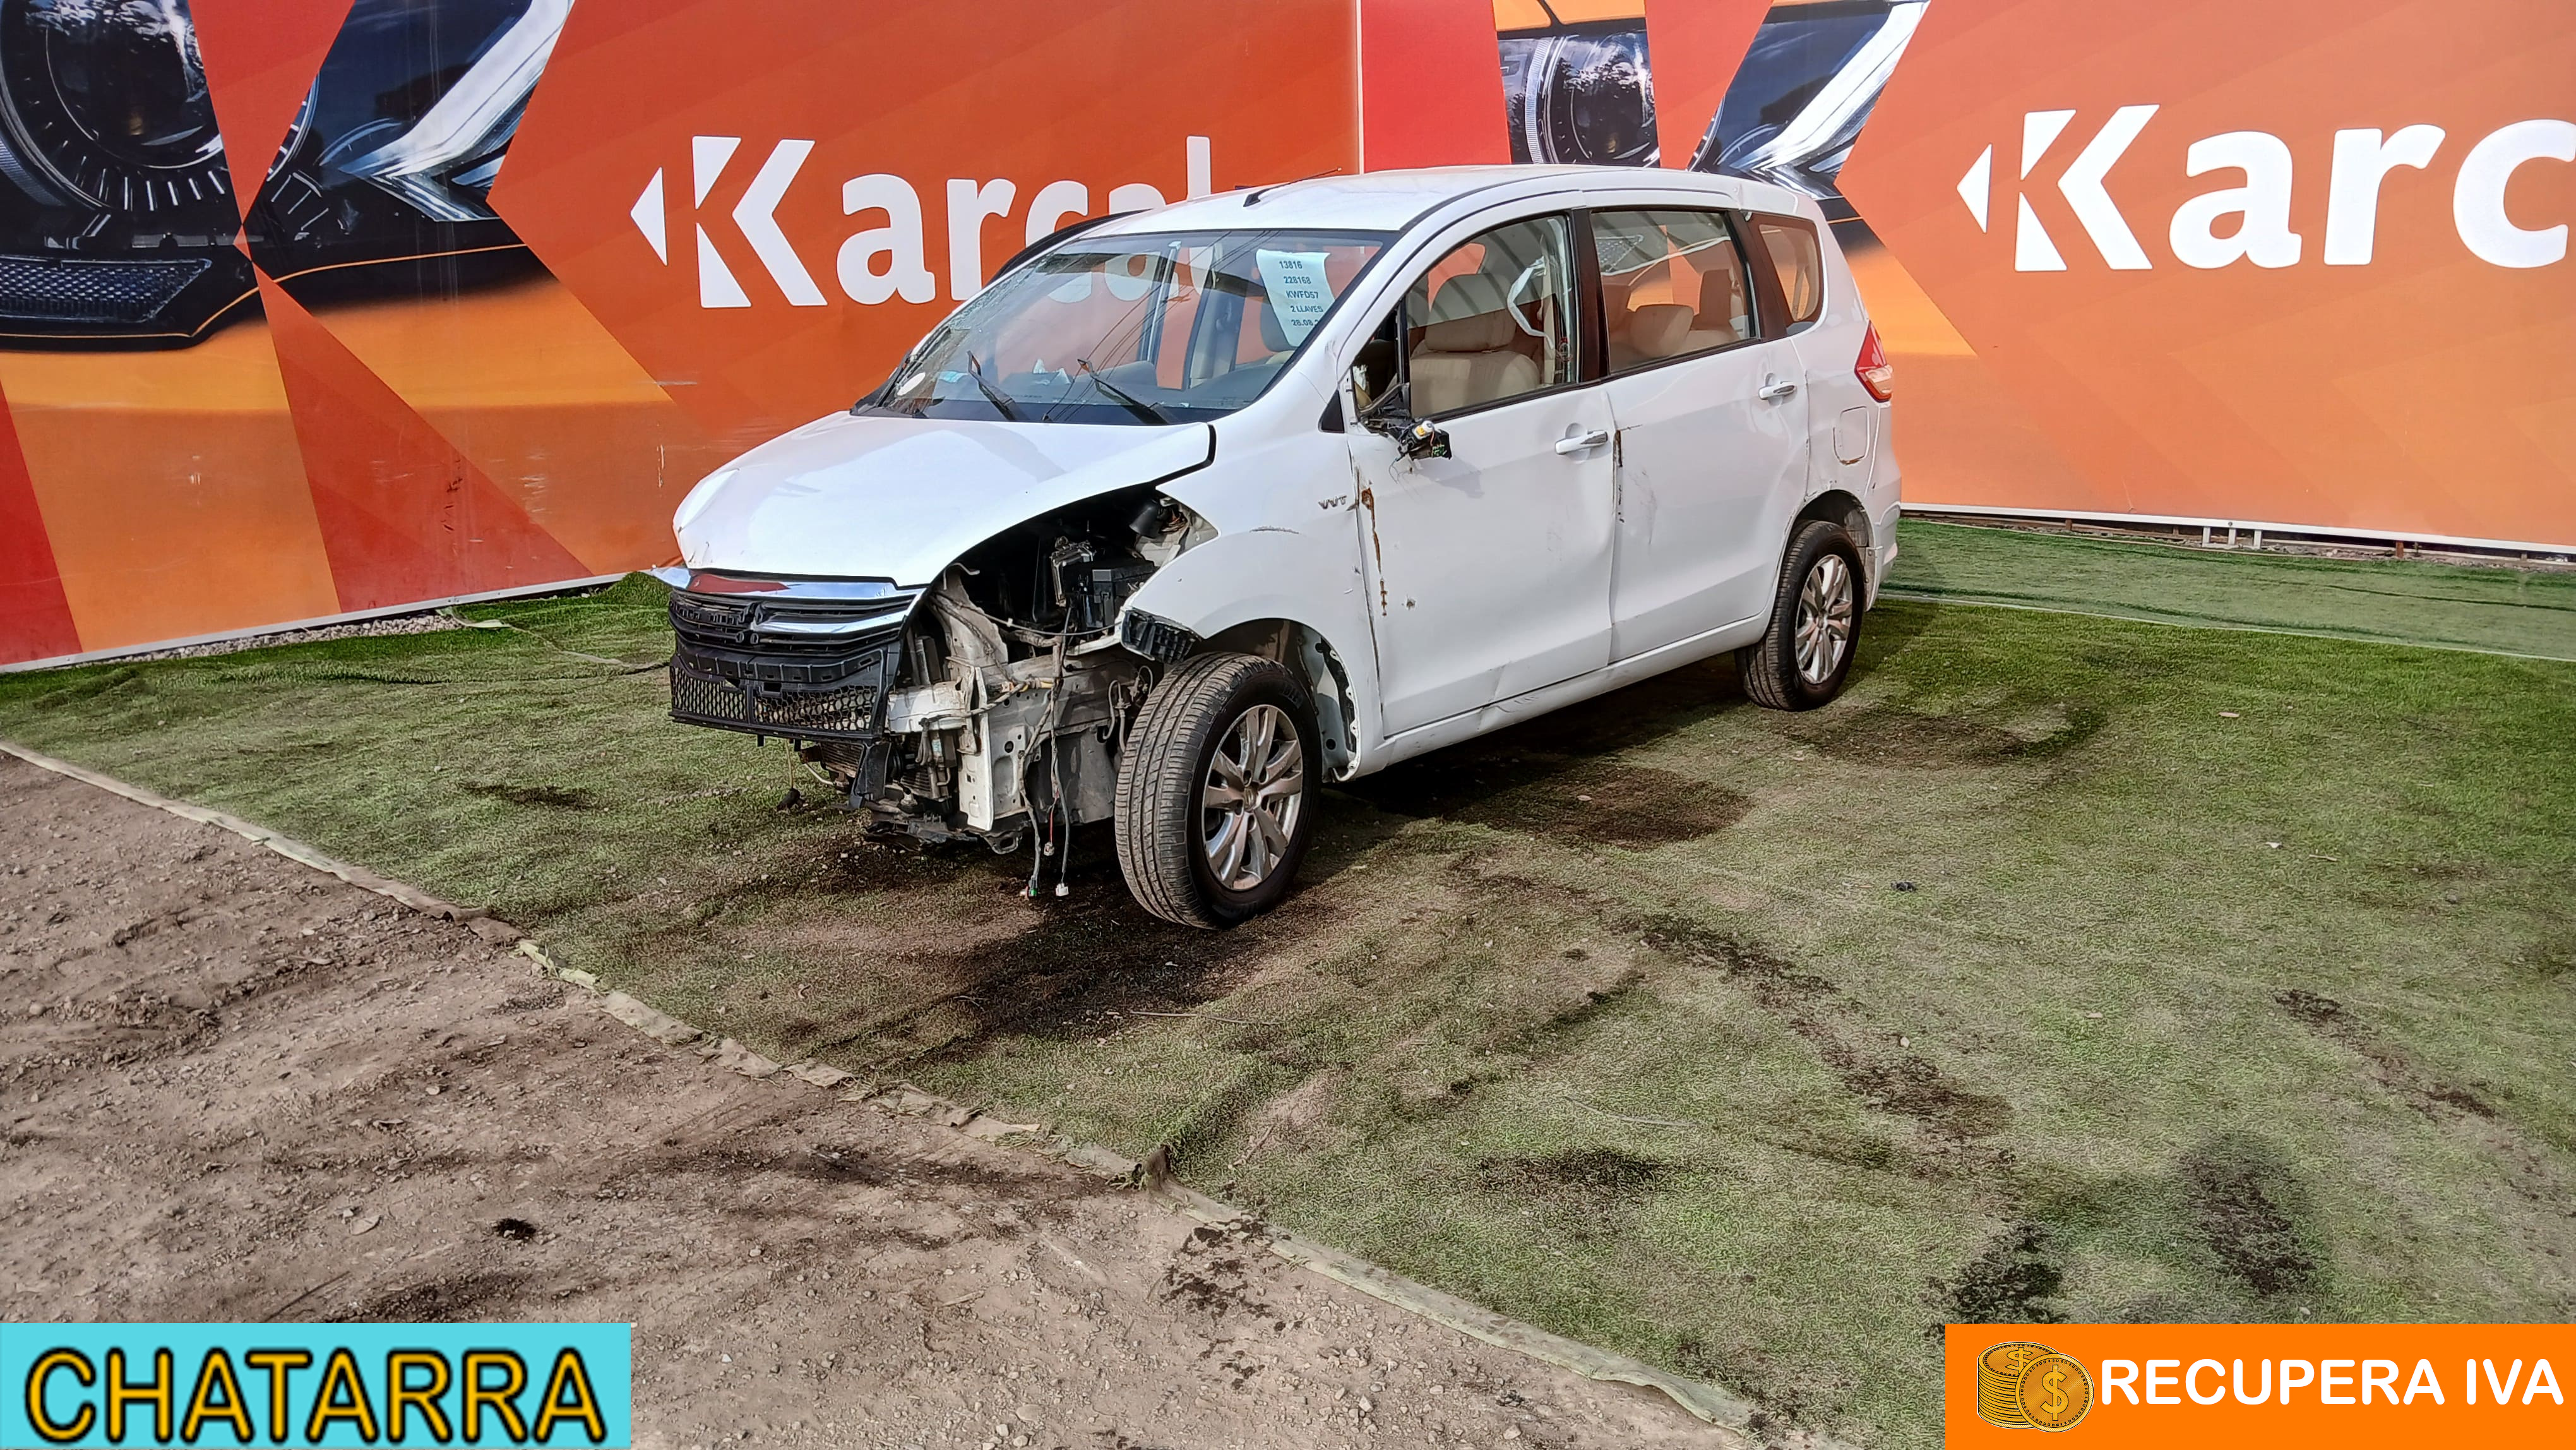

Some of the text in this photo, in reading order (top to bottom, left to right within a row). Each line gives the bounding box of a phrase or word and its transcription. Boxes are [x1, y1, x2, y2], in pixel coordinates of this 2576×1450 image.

[1279, 261, 1303, 269] 13816
[1284, 276, 1311, 284] 228168
[1286, 291, 1319, 299] KWFD57
